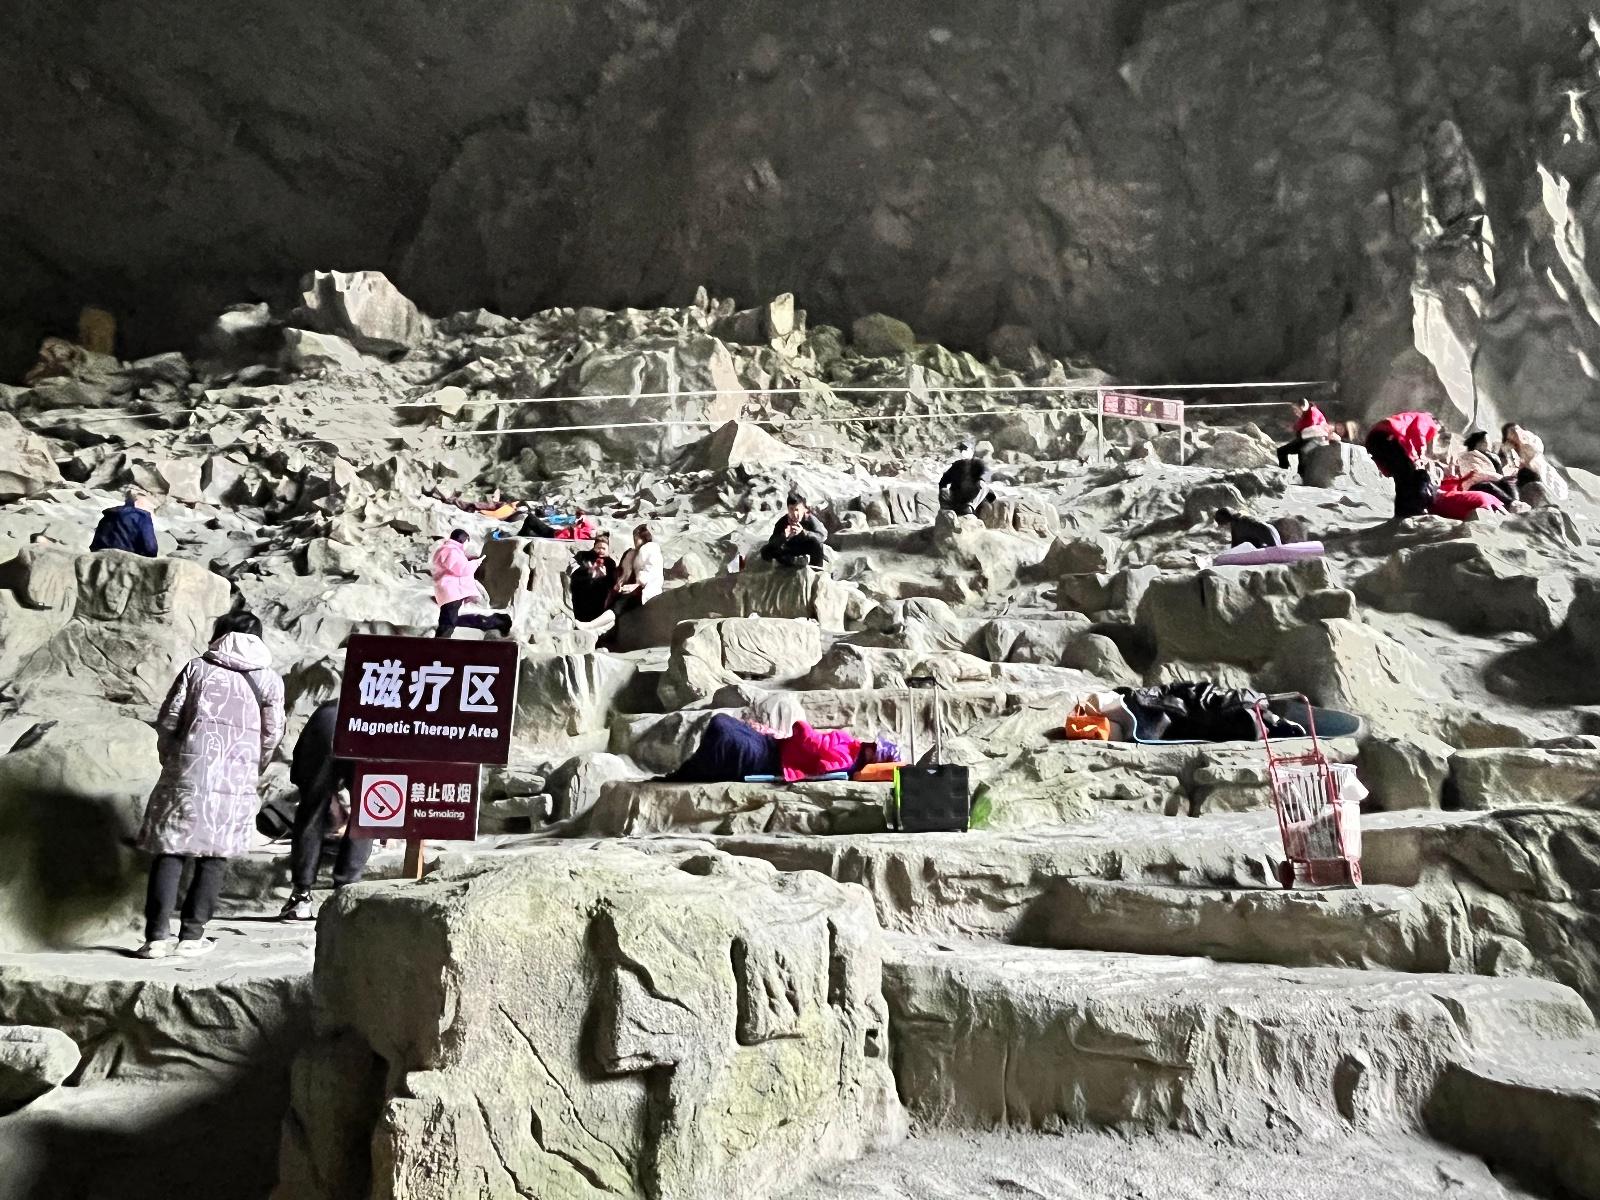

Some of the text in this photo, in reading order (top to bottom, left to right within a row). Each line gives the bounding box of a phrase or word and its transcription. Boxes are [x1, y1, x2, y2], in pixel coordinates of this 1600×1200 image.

[359, 660, 500, 713] 磁疗区
[348, 717, 499, 740] Magnetic Therapy Area
[410, 782, 472, 804] 禁止吸烟
[413, 808, 466, 821] No Smoking
